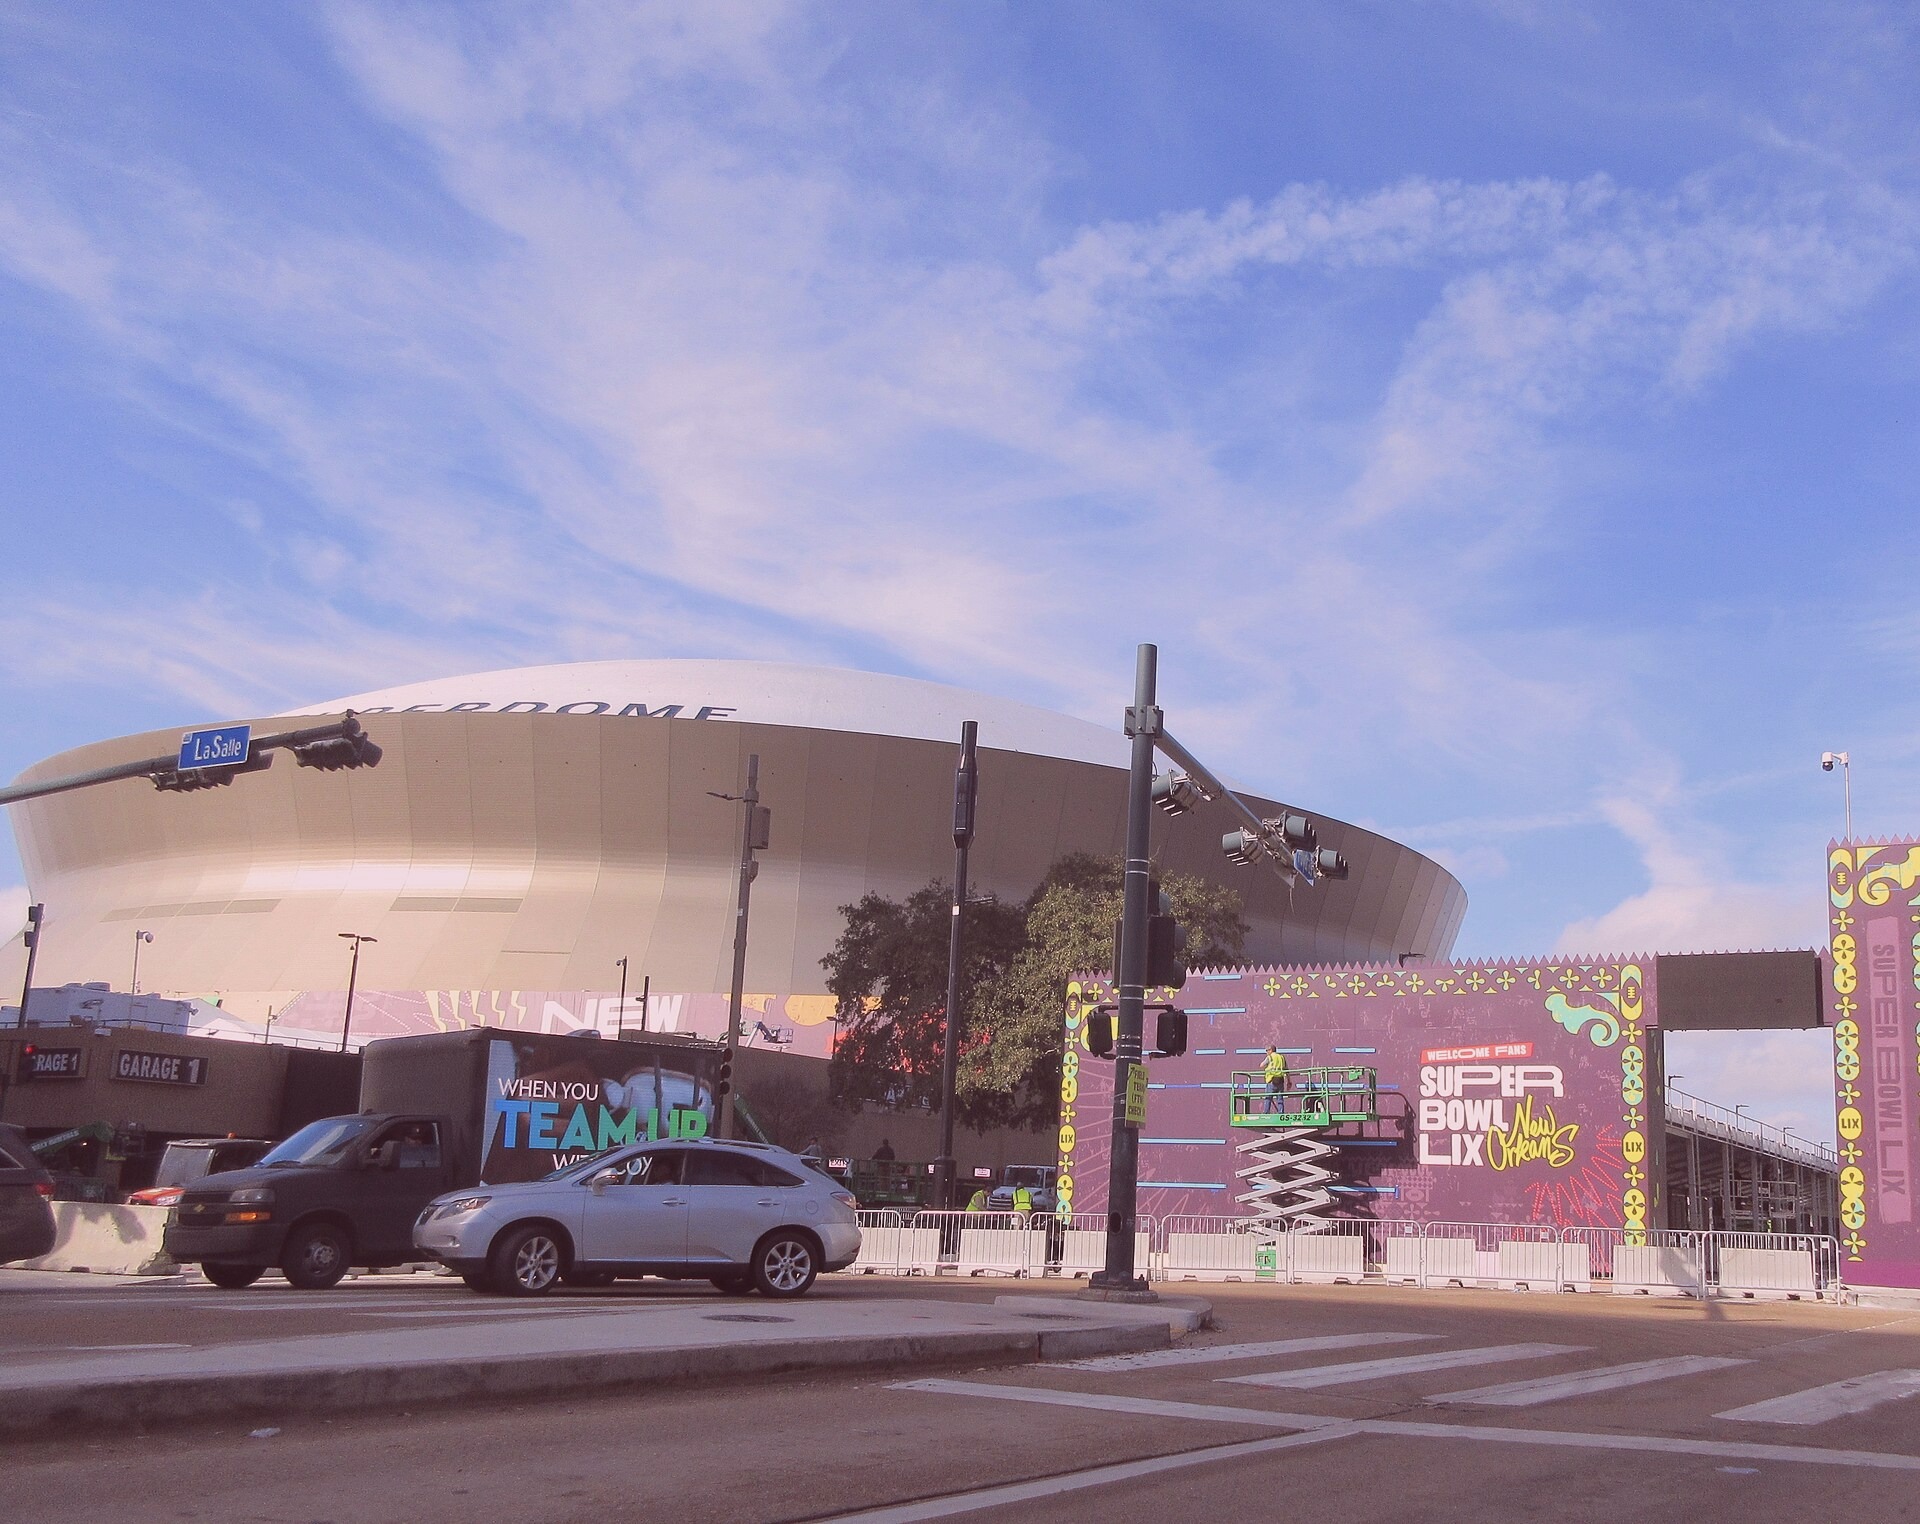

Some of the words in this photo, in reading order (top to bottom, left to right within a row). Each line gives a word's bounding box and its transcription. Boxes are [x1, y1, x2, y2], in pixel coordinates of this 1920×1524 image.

[1872, 943, 1899, 1039] SUPER
[541, 995, 683, 1040] NEW
[32, 1053, 69, 1071] RAGE
[71, 1053, 78, 1070] 1
[119, 1053, 181, 1080] GARAGE
[188, 1058, 200, 1083] 1
[1427, 1048, 1490, 1061] WELCOME
[1495, 1045, 1527, 1057] FANS
[498, 1078, 557, 1099] WHEN
[560, 1081, 599, 1101] YOU
[1419, 1065, 1564, 1098] SUPER
[1877, 1046, 1903, 1132] BOWL
[494, 1100, 638, 1151] TEAM
[1419, 1099, 1509, 1132] BOWL
[1503, 1094, 1556, 1148] New
[1841, 1118, 1859, 1129] LIX
[1060, 1134, 1073, 1144] LIX
[1419, 1133, 1485, 1167] LIX
[1625, 1142, 1642, 1153] LIX
[1879, 1140, 1906, 1195] LIX
